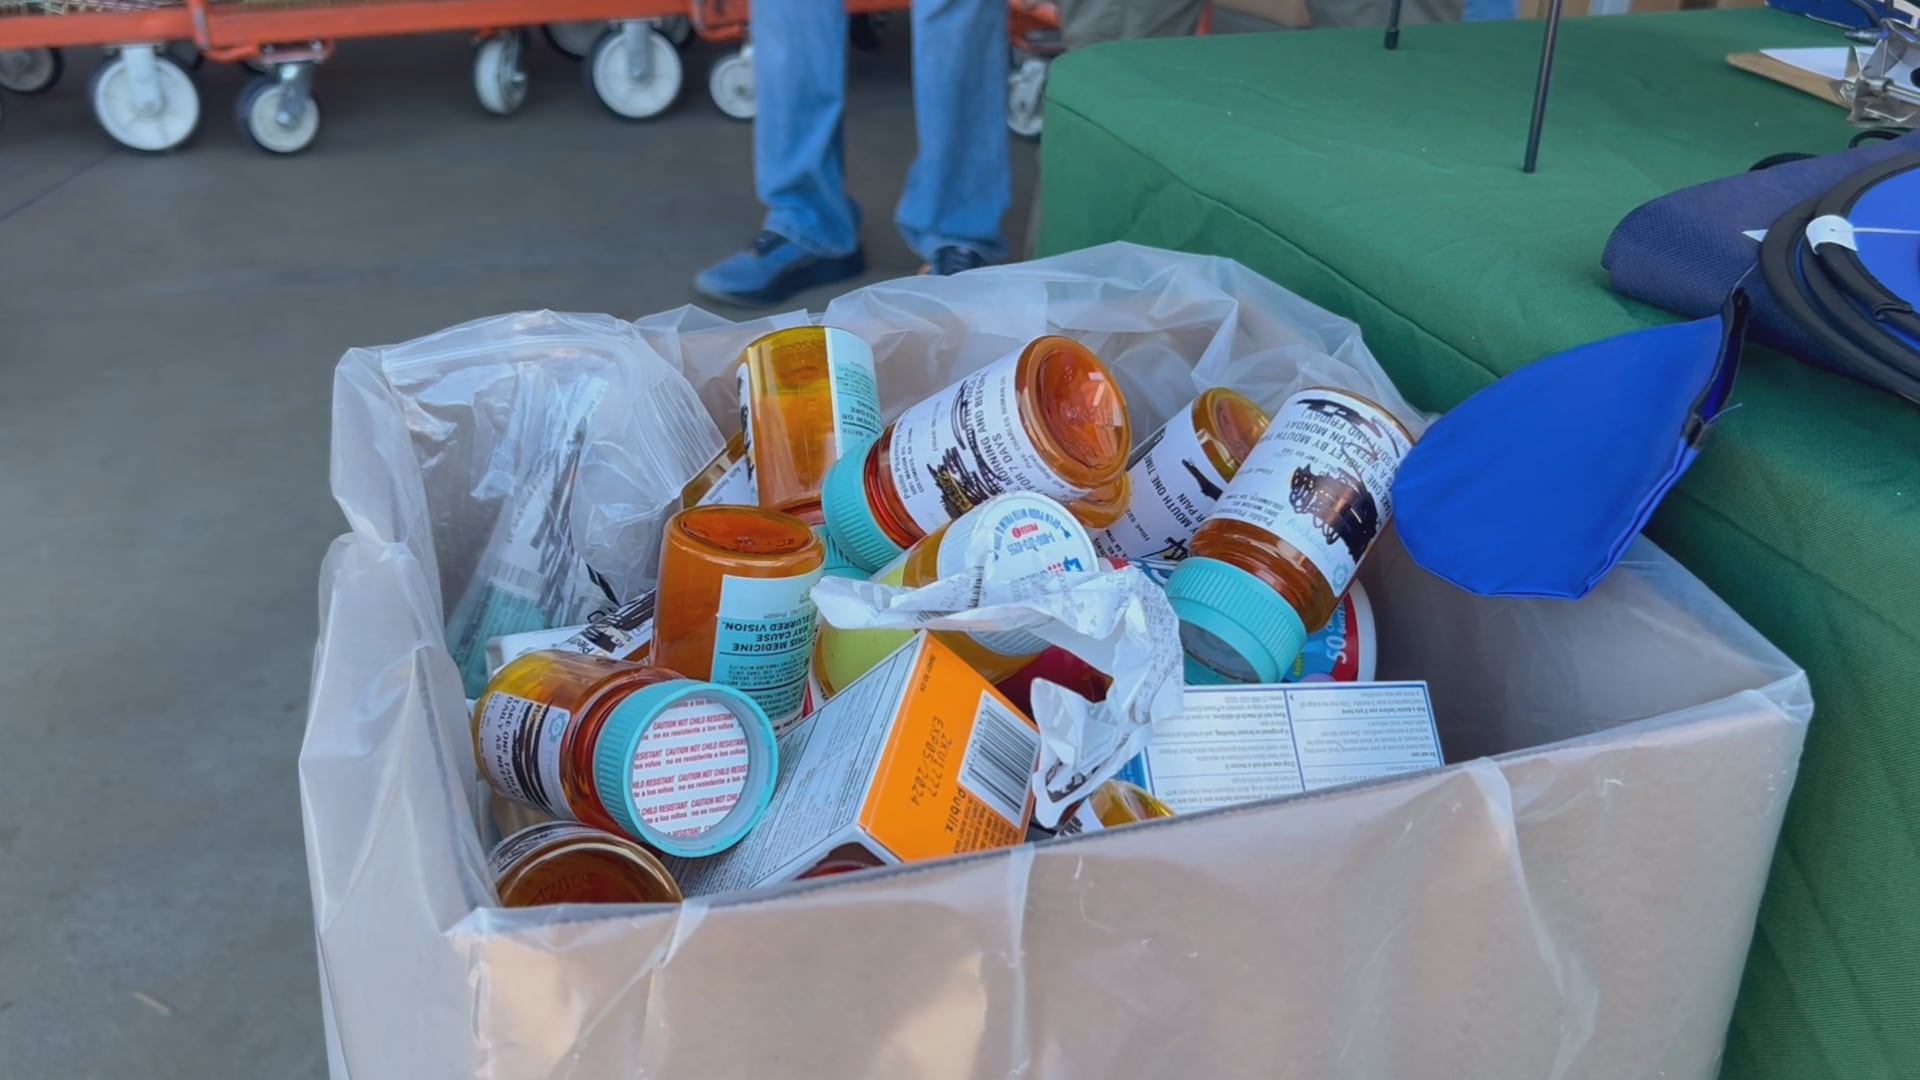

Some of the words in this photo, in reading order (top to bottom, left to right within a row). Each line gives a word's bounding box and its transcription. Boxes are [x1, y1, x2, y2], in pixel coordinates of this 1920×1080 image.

[971, 409, 990, 434] AND
[1276, 430, 1311, 444] MOUTH
[1313, 438, 1329, 451] BY
[992, 432, 1013, 463] DAYS
[978, 436, 1014, 485] MORNING
[1009, 464, 1019, 472] 7
[896, 474, 911, 499] Publix
[1014, 472, 1035, 490] FOR
[1150, 475, 1167, 496] ONE
[1366, 474, 1382, 494] ONE
[1162, 494, 1192, 528] MOUTH
[1176, 493, 1199, 515] PAIN
[722, 621, 766, 631] VISION.
[755, 630, 790, 642] CAUSE
[732, 639, 787, 651] MEDICINE
[790, 634, 807, 645] THIS
[1325, 635, 1347, 664] 50
[497, 697, 513, 731] DAILY
[504, 699, 520, 727] TAKE
[653, 720, 677, 730] CAUTION
[677, 718, 689, 727] NOT
[689, 716, 705, 725] CHILD
[670, 726, 701, 736] resistente
[717, 722, 734, 730] niños
[495, 734, 501, 751] AS
[665, 745, 689, 756] CAUTION
[689, 744, 701, 752] NOT
[701, 741, 717, 750] CHILD
[644, 760, 661, 768] niños
[683, 752, 712, 762] resistente
[908, 715, 944, 806] EXP05/2024
[632, 780, 645, 789] HILD
[645, 775, 676, 786] RESISTANT
[677, 771, 701, 782] CAUTION
[702, 770, 713, 778] NOT
[713, 767, 729, 776] CHILD
[730, 765, 747, 773] RESIS
[696, 778, 725, 787] resistente
[641, 806, 658, 815] CHILD
[658, 801, 689, 812] RESISTANT
[690, 797, 713, 808] CAUTION
[714, 795, 726, 803] NOT
[944, 786, 967, 834] Publix
